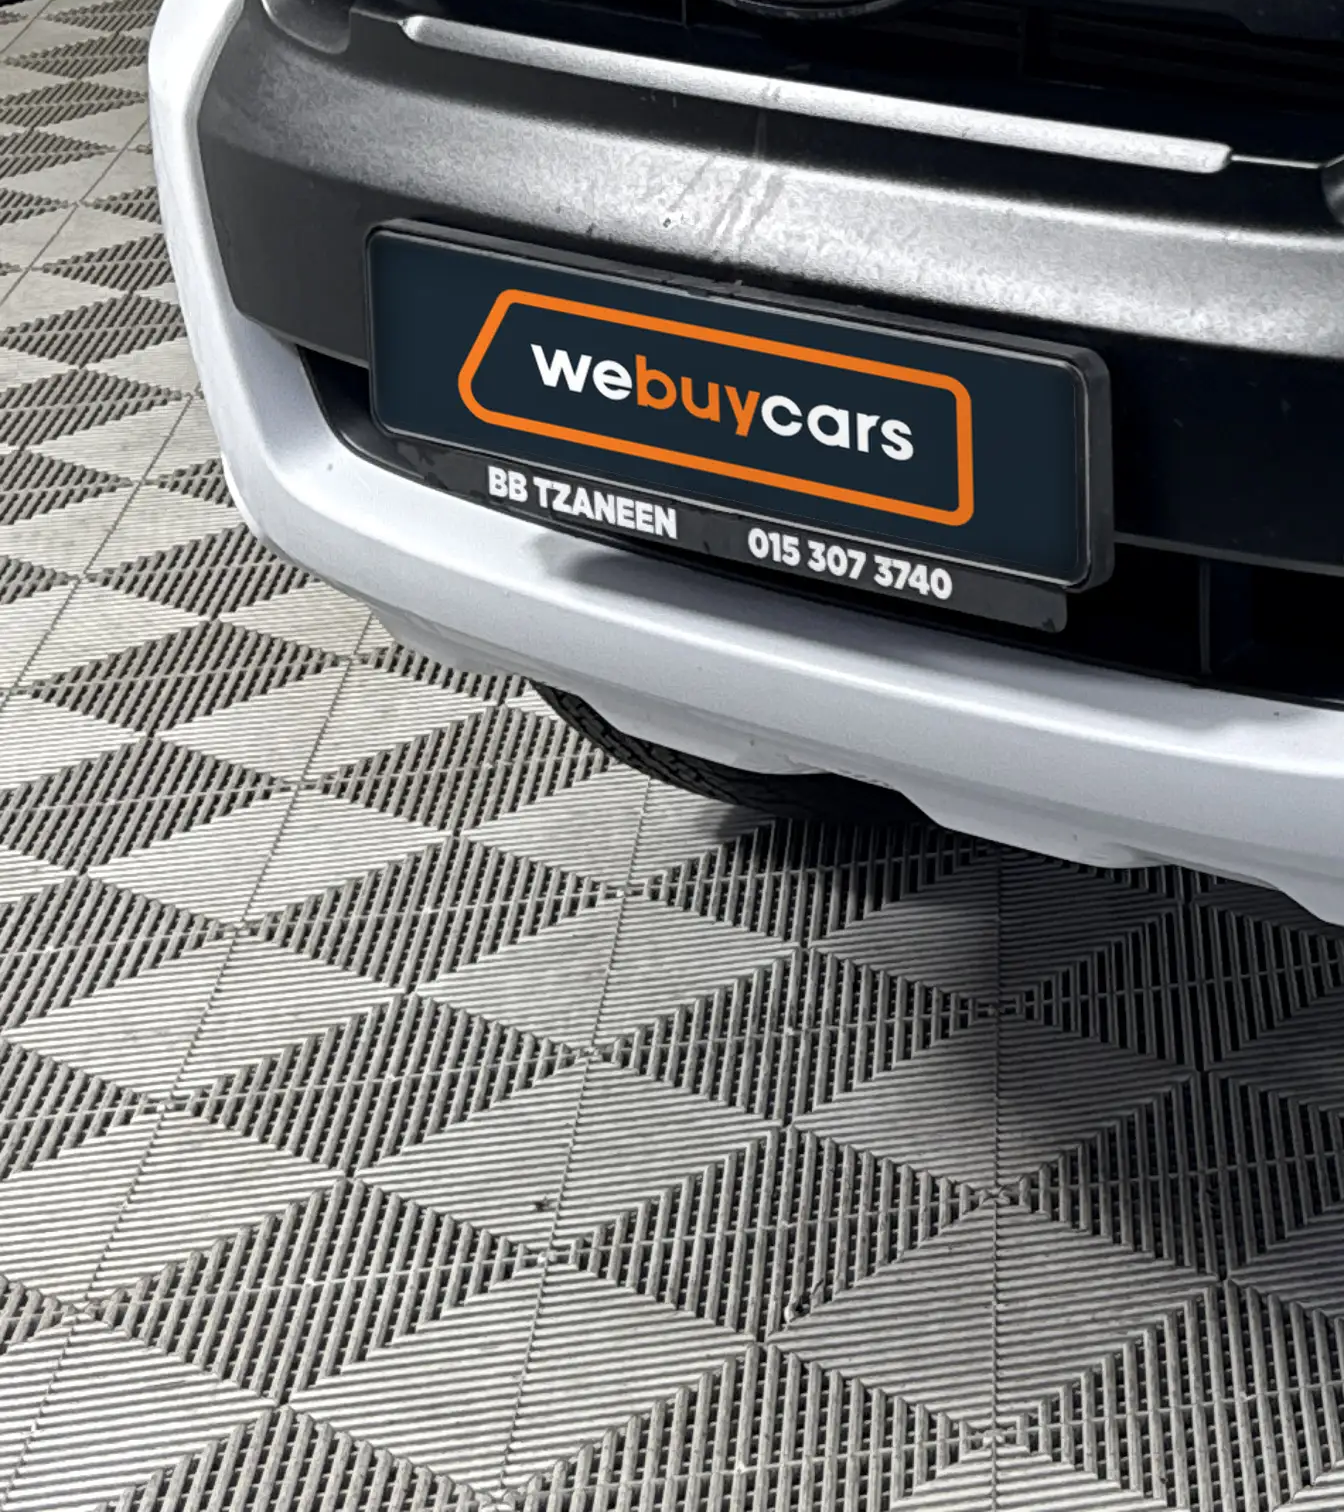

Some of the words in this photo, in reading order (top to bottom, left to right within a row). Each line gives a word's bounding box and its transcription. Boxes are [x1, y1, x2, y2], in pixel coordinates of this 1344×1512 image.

[486, 466, 528, 502] BB
[534, 475, 677, 539] TZANEEN
[747, 528, 800, 568] 015
[806, 540, 866, 581] 307
[873, 554, 954, 600] 3740
